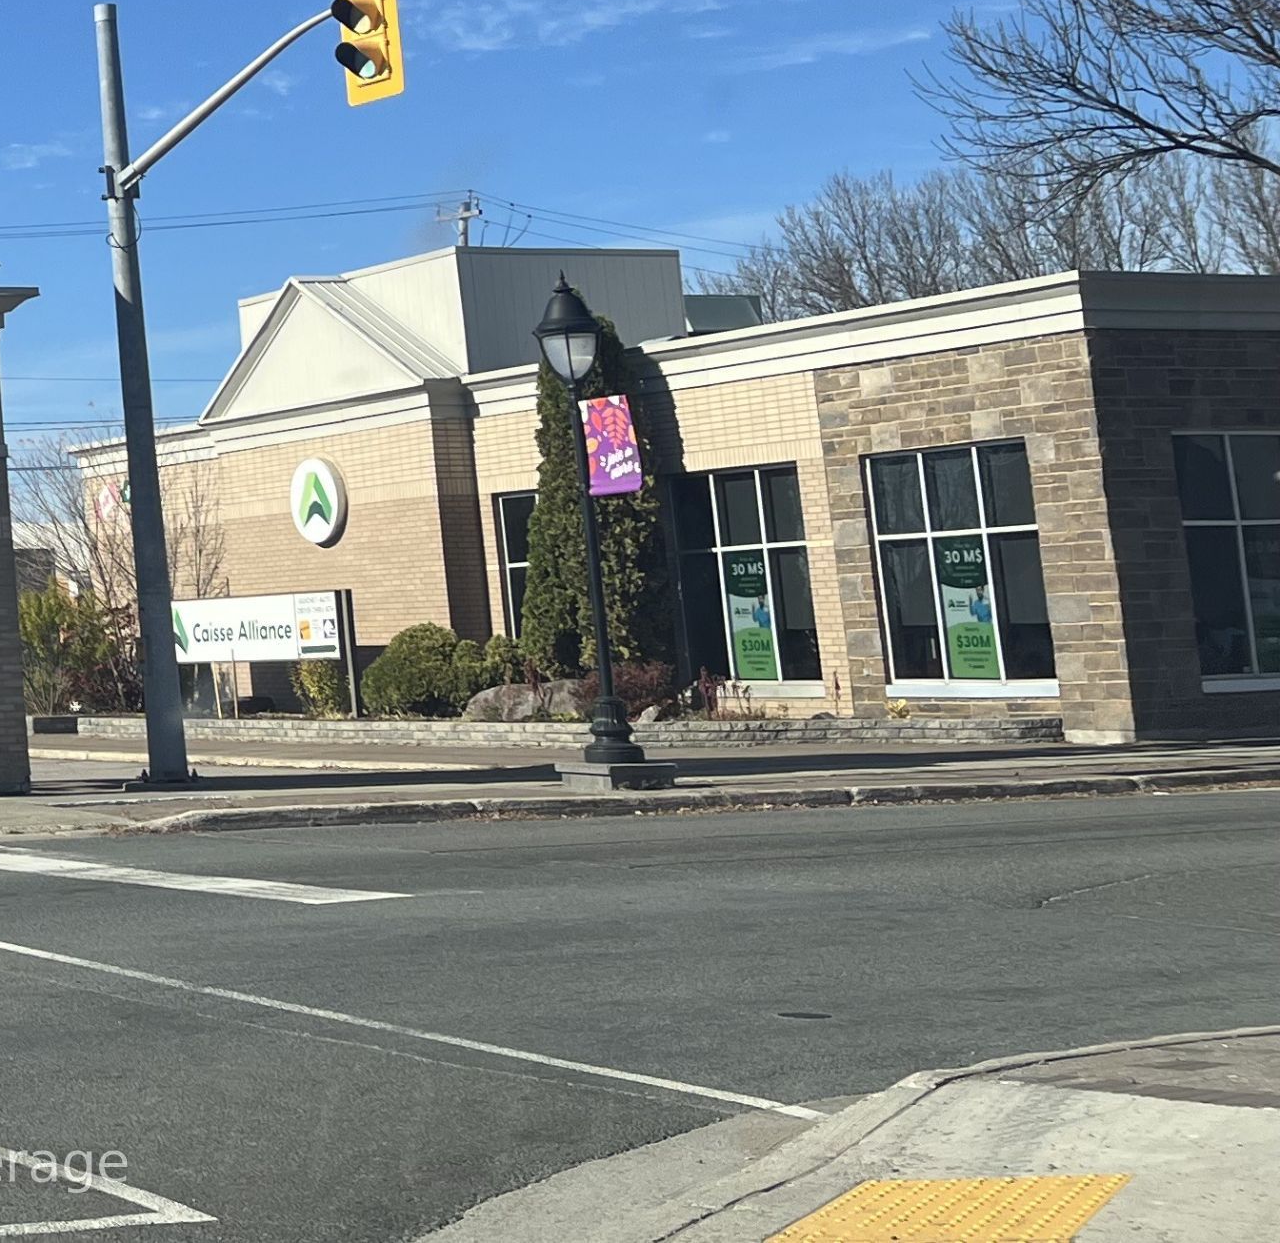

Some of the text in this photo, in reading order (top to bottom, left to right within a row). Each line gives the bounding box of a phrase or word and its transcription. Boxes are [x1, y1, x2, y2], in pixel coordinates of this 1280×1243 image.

[943, 548, 983, 564] 30 M$
[731, 561, 764, 576] 30 M$
[192, 621, 234, 643] Caisse
[237, 619, 292, 642] Alliance
[741, 638, 771, 653] $30M
[956, 635, 991, 649] $30M
